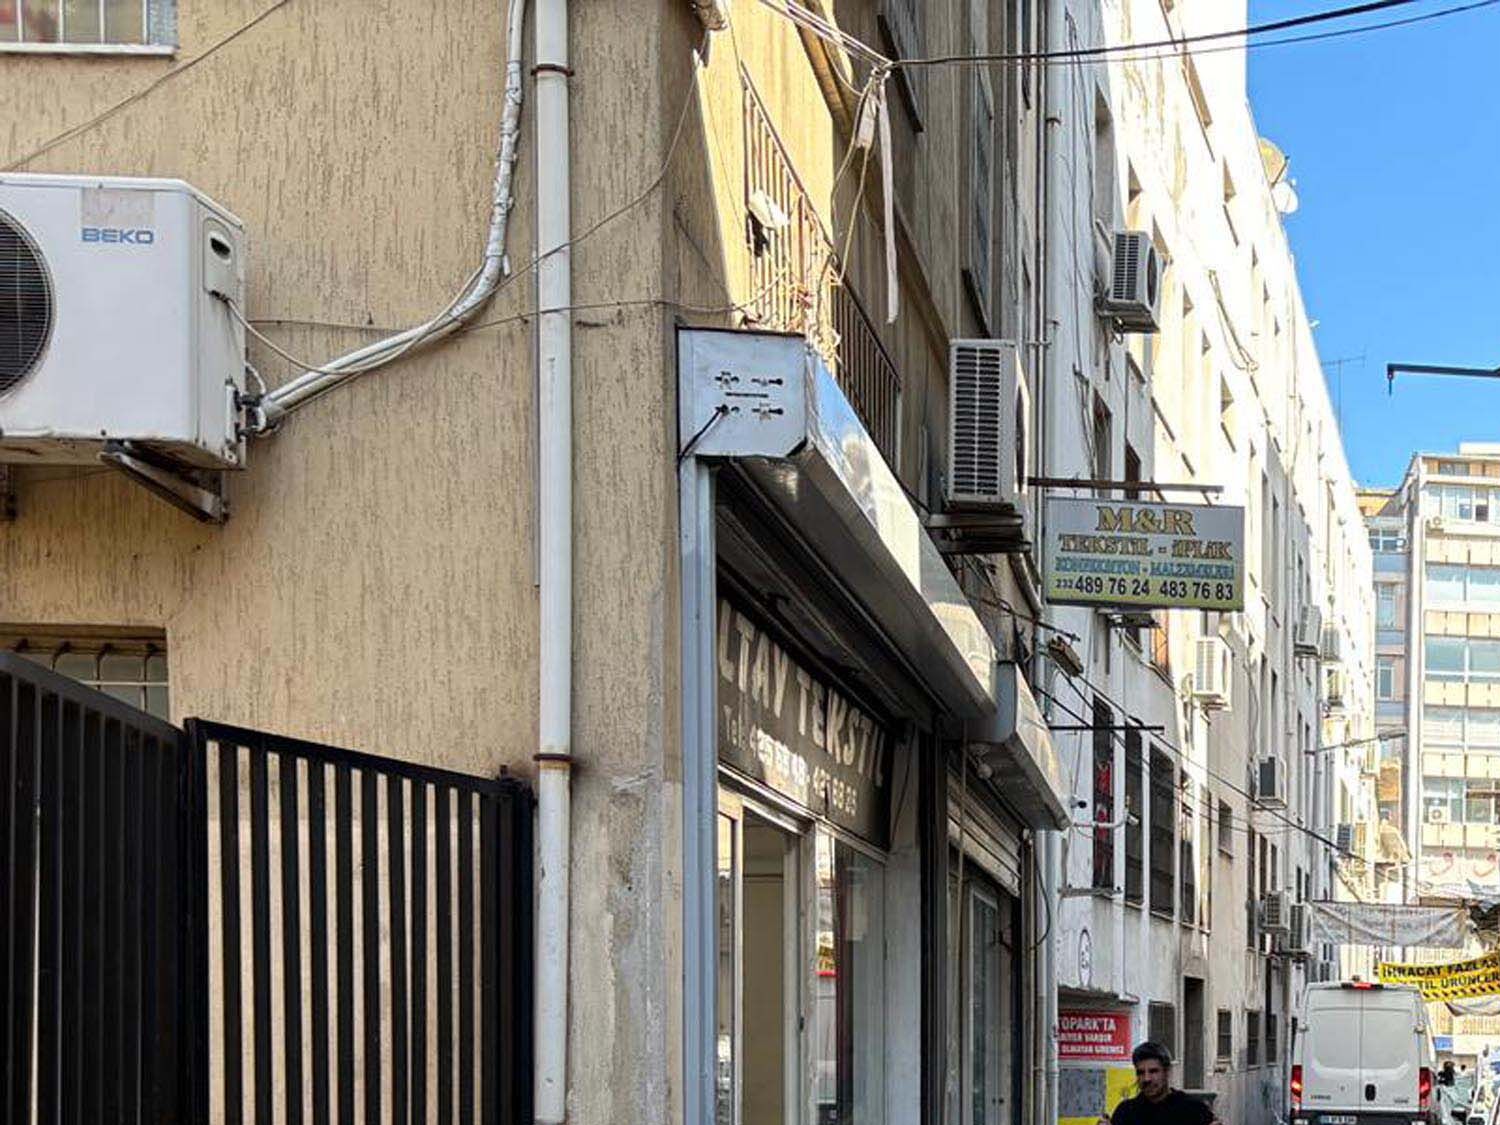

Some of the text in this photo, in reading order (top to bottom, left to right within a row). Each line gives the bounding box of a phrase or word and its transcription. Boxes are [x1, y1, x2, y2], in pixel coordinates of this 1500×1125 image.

[82, 228, 154, 244] BEKO
[1095, 506, 1196, 536] M&R
[1075, 576, 1103, 594] 489
[1109, 577, 1127, 595] 76
[1132, 579, 1150, 596] 24
[1160, 580, 1187, 599] 483
[1193, 582, 1211, 599] 76
[1215, 583, 1233, 601] 83
